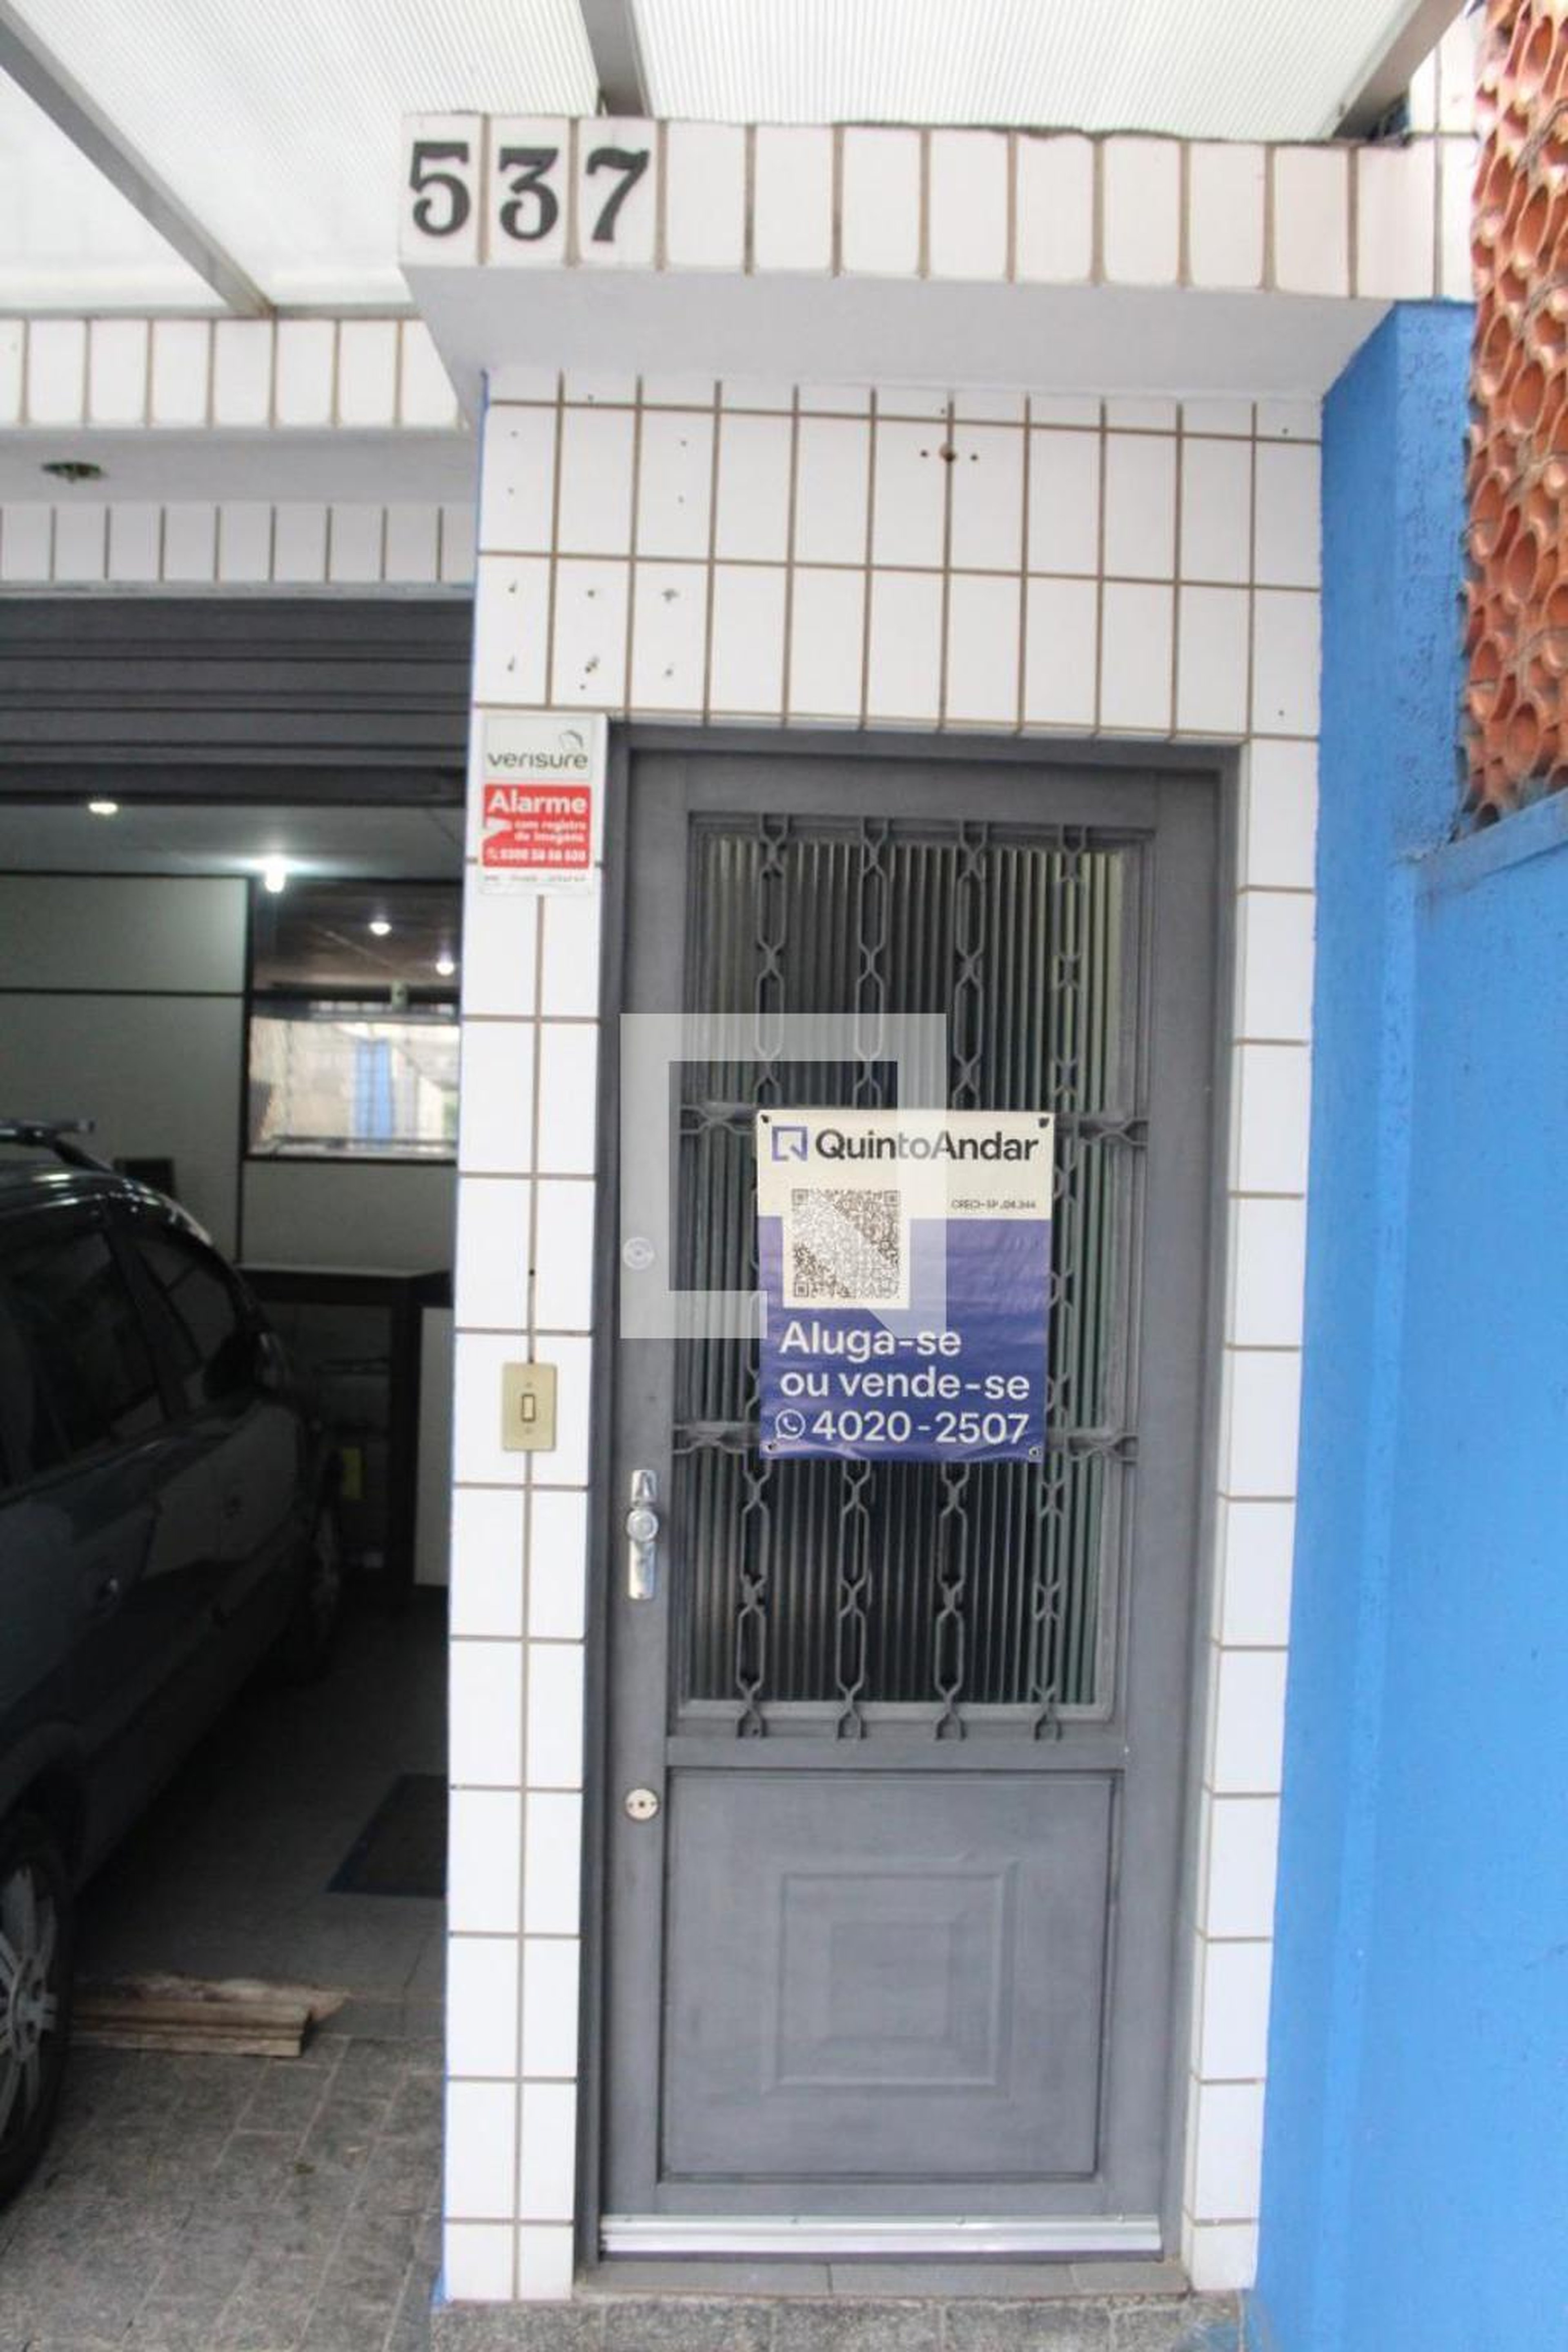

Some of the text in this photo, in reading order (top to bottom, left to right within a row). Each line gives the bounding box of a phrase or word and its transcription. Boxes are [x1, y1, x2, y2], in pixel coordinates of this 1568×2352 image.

[410, 141, 650, 243] 537
[487, 752, 588, 768] verisure
[486, 788, 587, 814] Alarme
[817, 1129, 1039, 1161] QuintoAndar
[779, 1321, 961, 1363] Aluga-se
[780, 1366, 1030, 1400] ou vende-se
[812, 1410, 1029, 1445] 4020-2507
